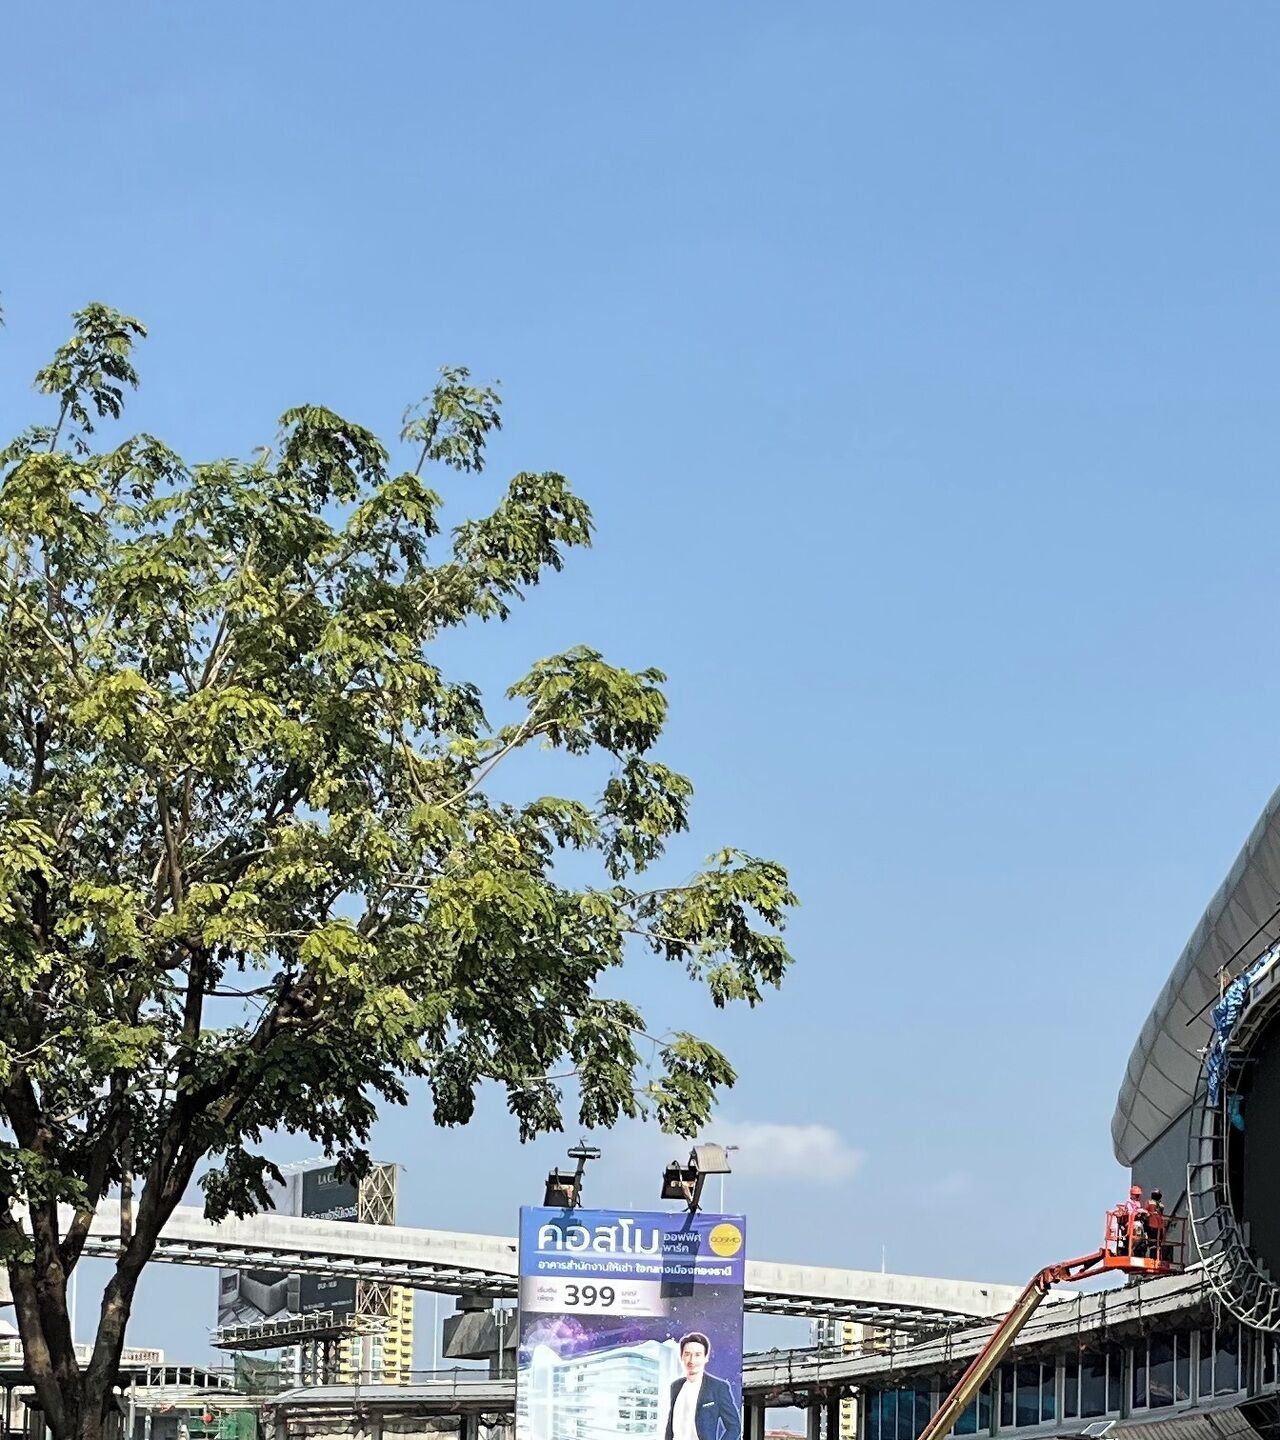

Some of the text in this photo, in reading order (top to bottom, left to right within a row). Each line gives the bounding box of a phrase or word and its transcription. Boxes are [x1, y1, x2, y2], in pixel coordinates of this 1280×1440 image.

[537, 1218, 659, 1255] คอสโม
[663, 1232, 702, 1242] ออฟฟิศ
[538, 1260, 632, 1273] อาคารสำนักงานให้เช่า
[564, 1284, 616, 1307] 399
